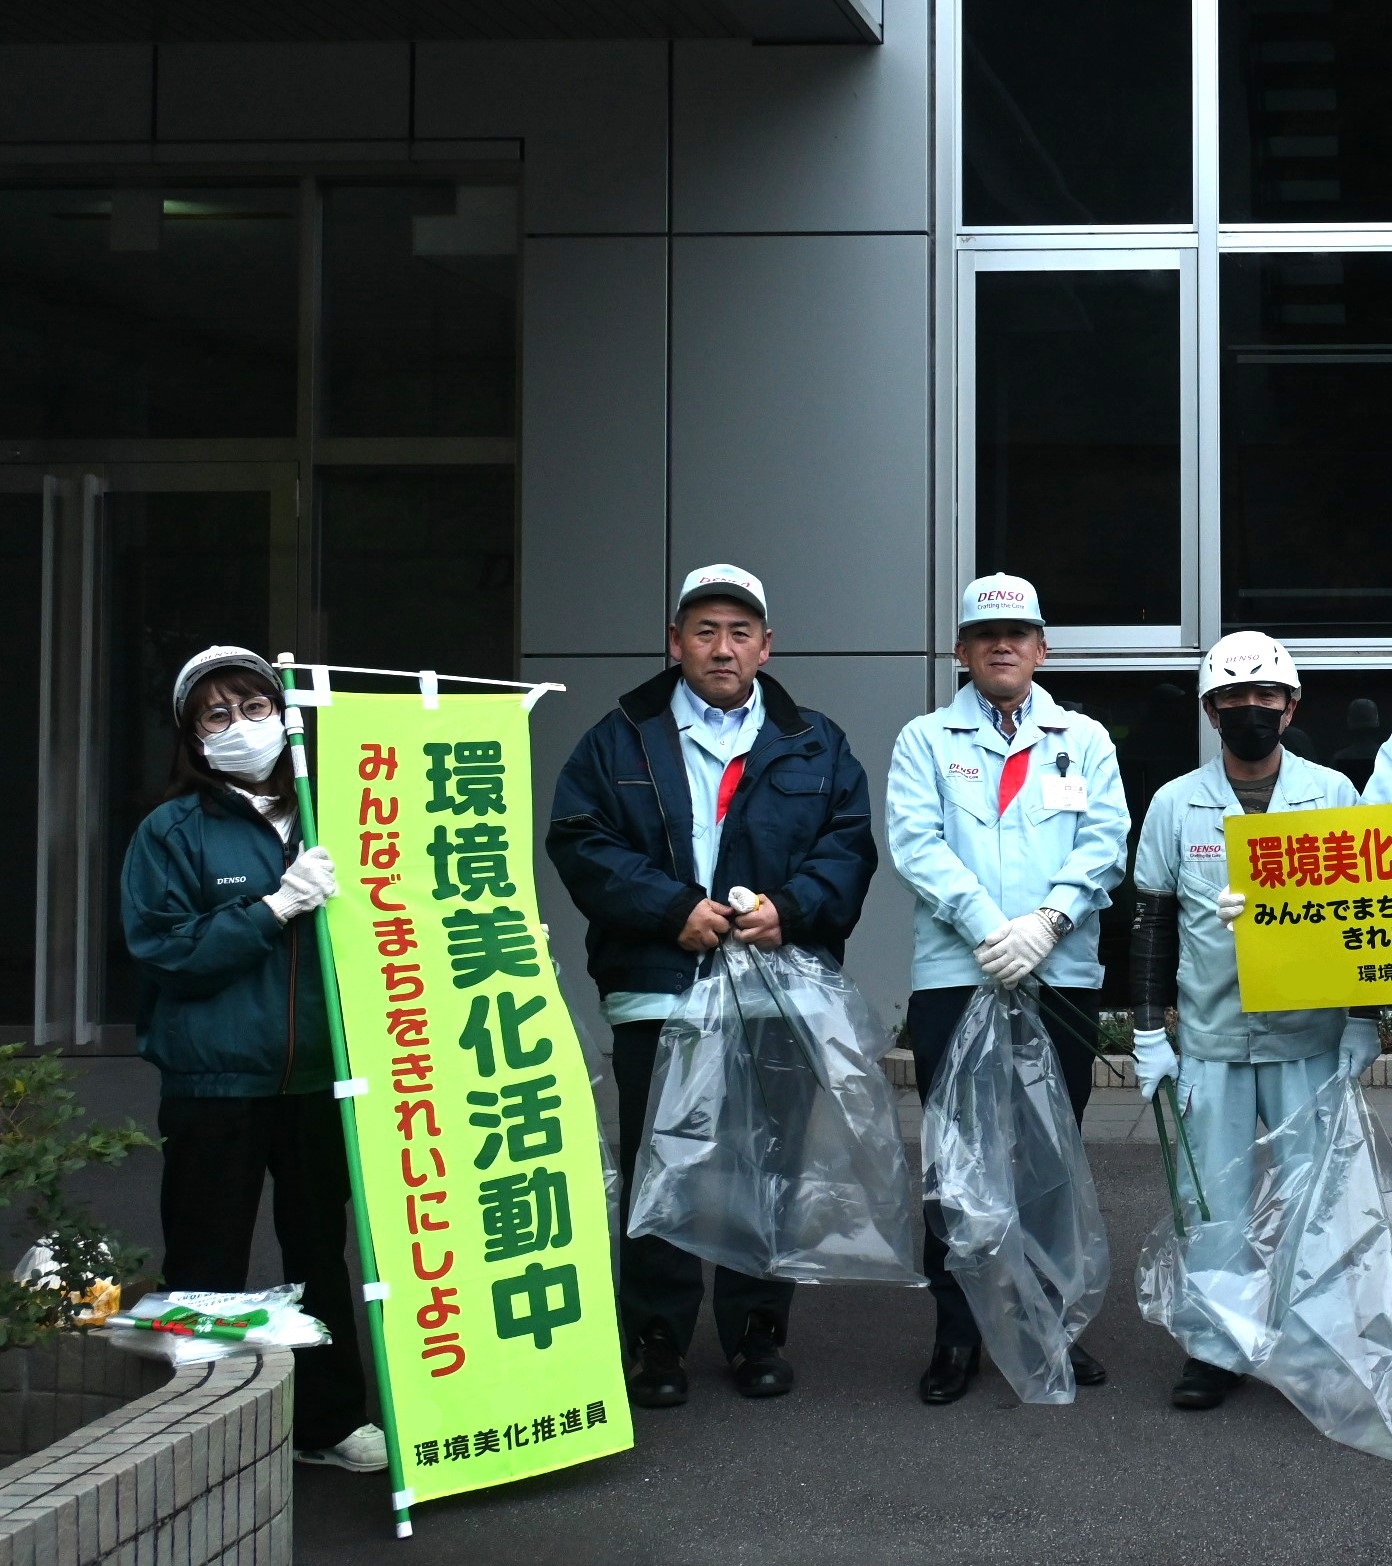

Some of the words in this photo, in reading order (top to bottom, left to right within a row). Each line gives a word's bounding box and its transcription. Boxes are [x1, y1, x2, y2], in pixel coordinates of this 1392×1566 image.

[978, 590, 1025, 603] DENSO
[1225, 654, 1260, 664] DENSO
[1190, 845, 1221, 853] DENSO
[216, 875, 247, 885] DENSO
[422, 740, 582, 1350] 環境美化活動中
[360, 743, 466, 1378] みんなでまちをきれいにしよう
[414, 1400, 608, 1467] 環境美化推進員
